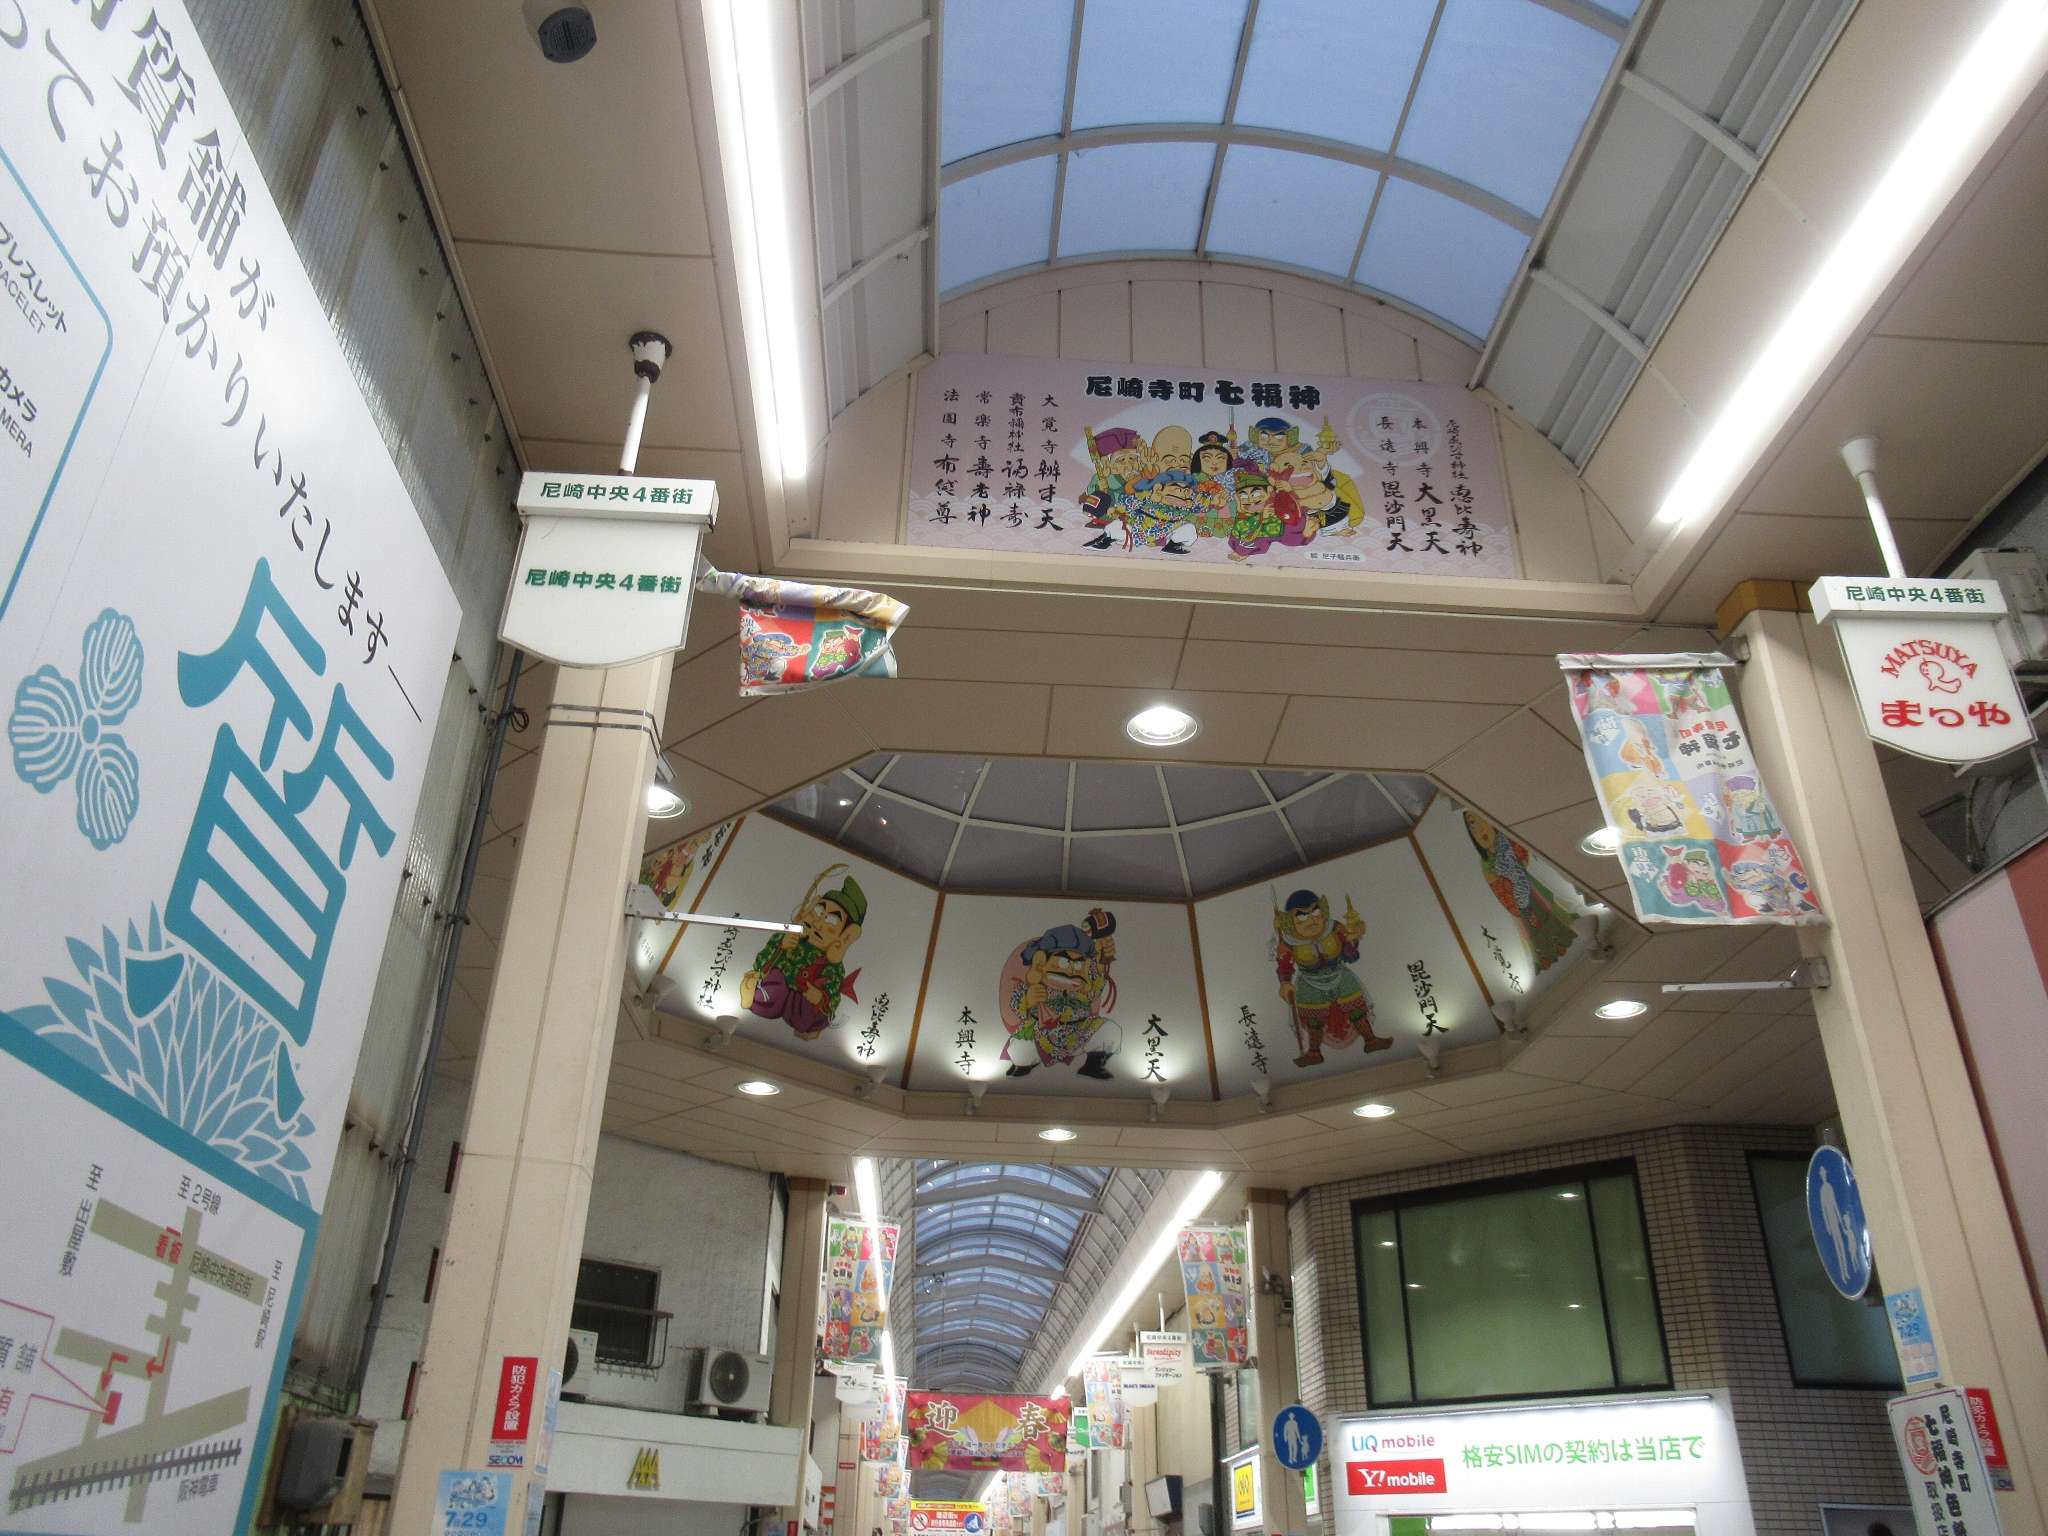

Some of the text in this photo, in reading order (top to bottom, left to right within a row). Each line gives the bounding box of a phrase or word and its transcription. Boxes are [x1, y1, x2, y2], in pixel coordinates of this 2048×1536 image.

[1086, 375, 1320, 410] 尼崎寺町七福神
[540, 481, 694, 505] 尼崎中央4番街
[525, 568, 683, 595] 尼崎中央4番街
[1846, 585, 1985, 604] 尼崎中央4番街
[1880, 639, 1978, 679] MATSUYA
[1881, 700, 2011, 728] まつや
[1406, 959, 1449, 1037] 毘沙門天
[954, 1005, 978, 1076] 本興寺
[1139, 1013, 1169, 1082] 大黒天
[503, 1365, 527, 1431] 防犯カメラ設置
[1351, 1434, 1435, 1454] UQ mobile
[1462, 1435, 1705, 1470] 格安SIMの契約は当店で
